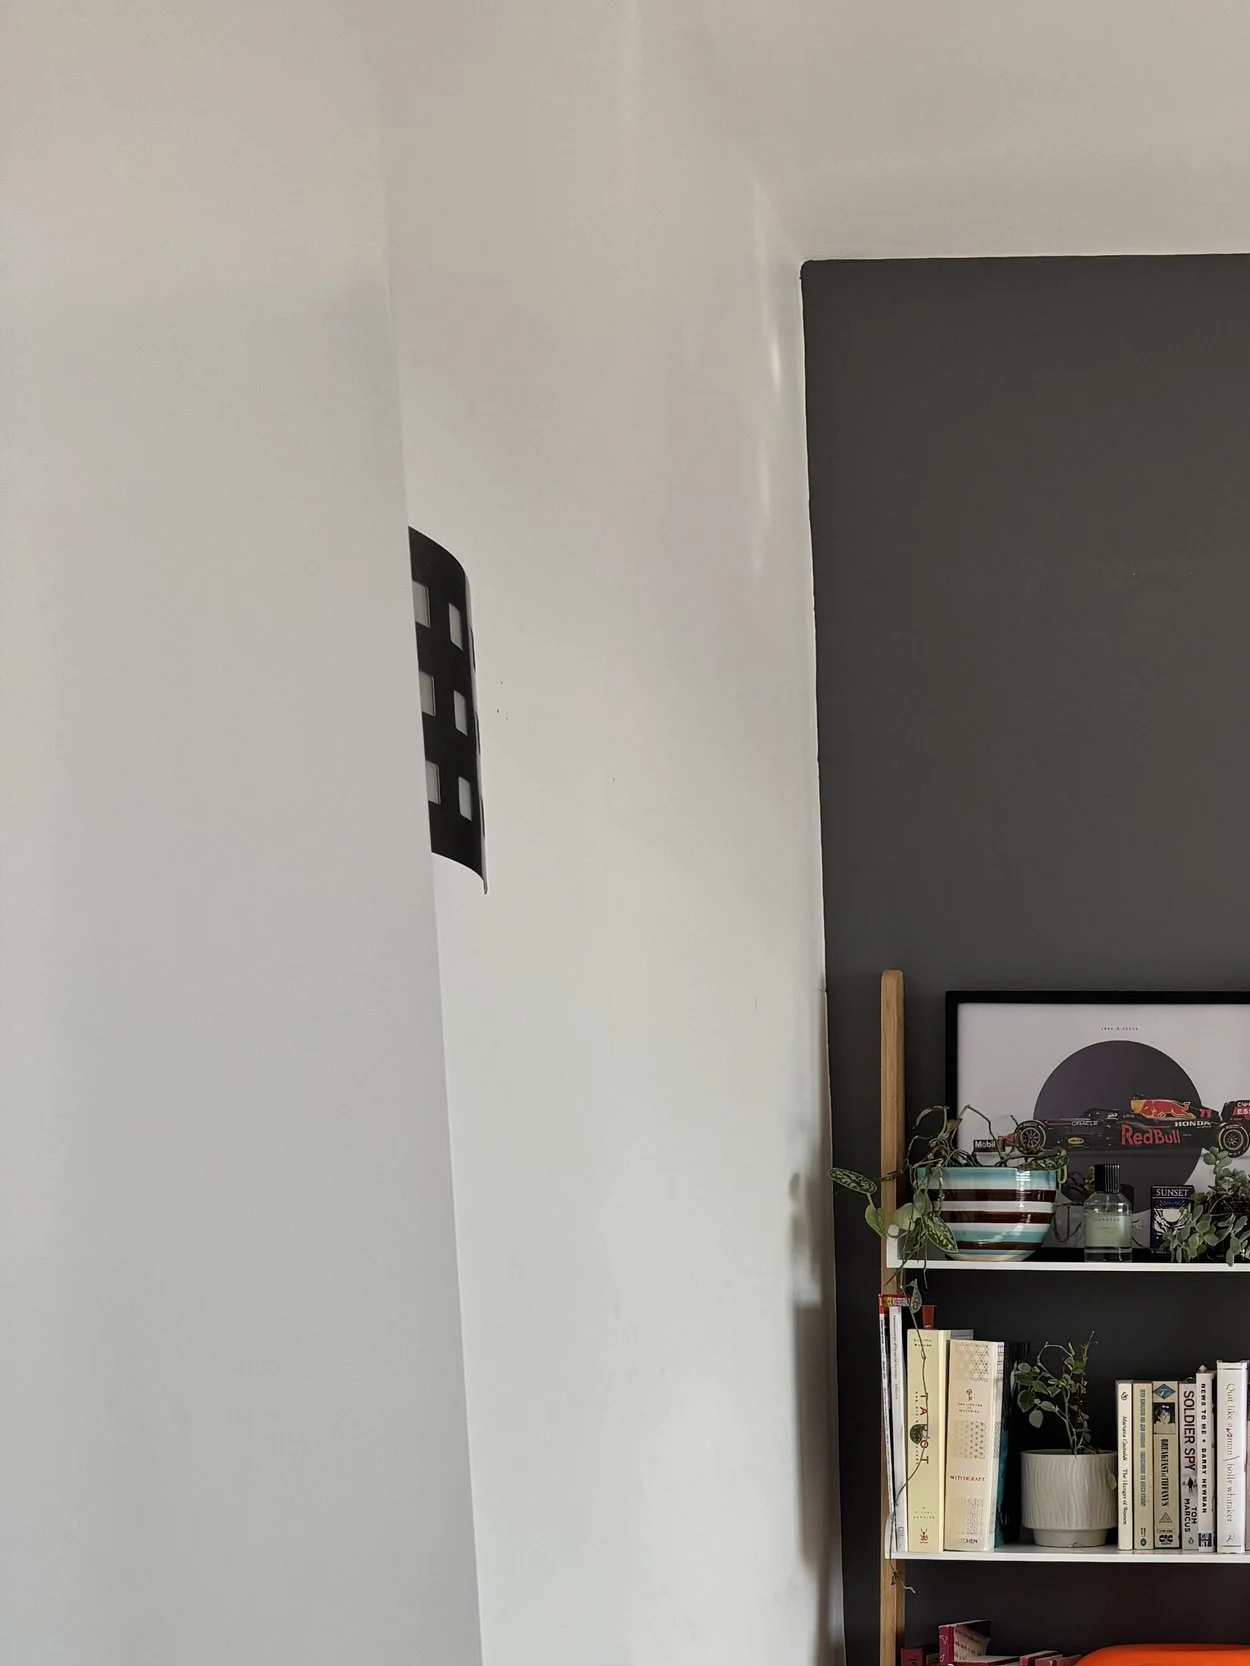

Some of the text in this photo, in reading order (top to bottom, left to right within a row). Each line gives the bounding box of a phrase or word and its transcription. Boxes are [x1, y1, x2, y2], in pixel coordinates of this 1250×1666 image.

[1174, 1120, 1211, 1128] HONDA
[1156, 1188, 1189, 1198] SUNSET
[1225, 1383, 1236, 1420] Quit like
[1201, 1409, 1207, 1420] TO
[1183, 1390, 1196, 1472] SOLDIER SPY
[1201, 1423, 1207, 1435] ME
[1224, 1463, 1236, 1523] holly whitaker
[1184, 1498, 1192, 1533] MARCUS
